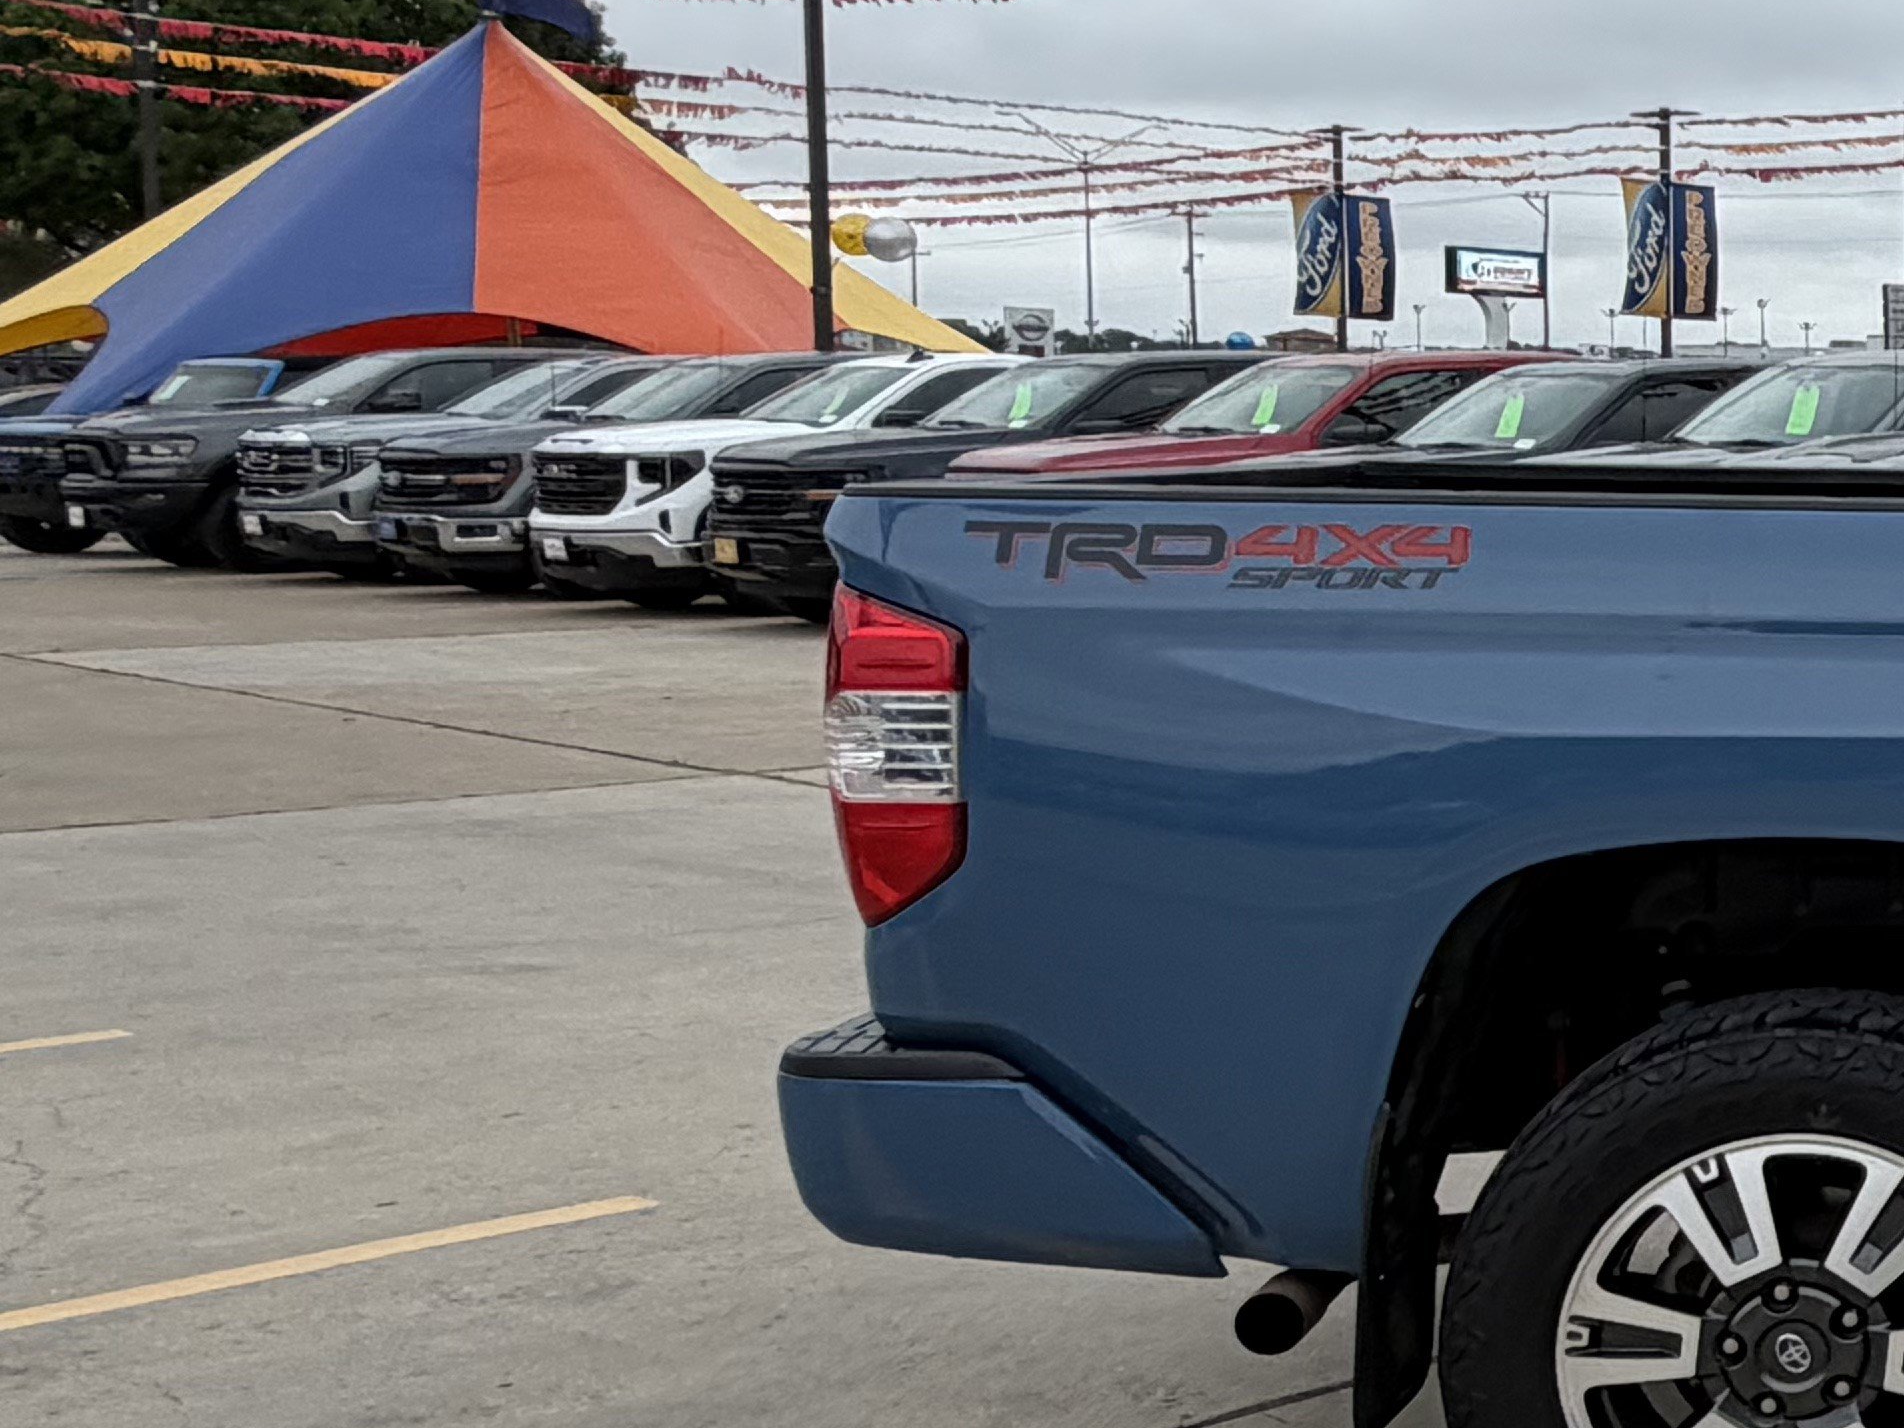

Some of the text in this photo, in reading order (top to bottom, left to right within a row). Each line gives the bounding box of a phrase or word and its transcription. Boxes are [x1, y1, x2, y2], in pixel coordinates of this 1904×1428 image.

[1297, 211, 1339, 297] Ford
[1628, 202, 1666, 294] Ford
[964, 520, 1231, 582] TRD
[1226, 566, 1459, 591] SPORT
